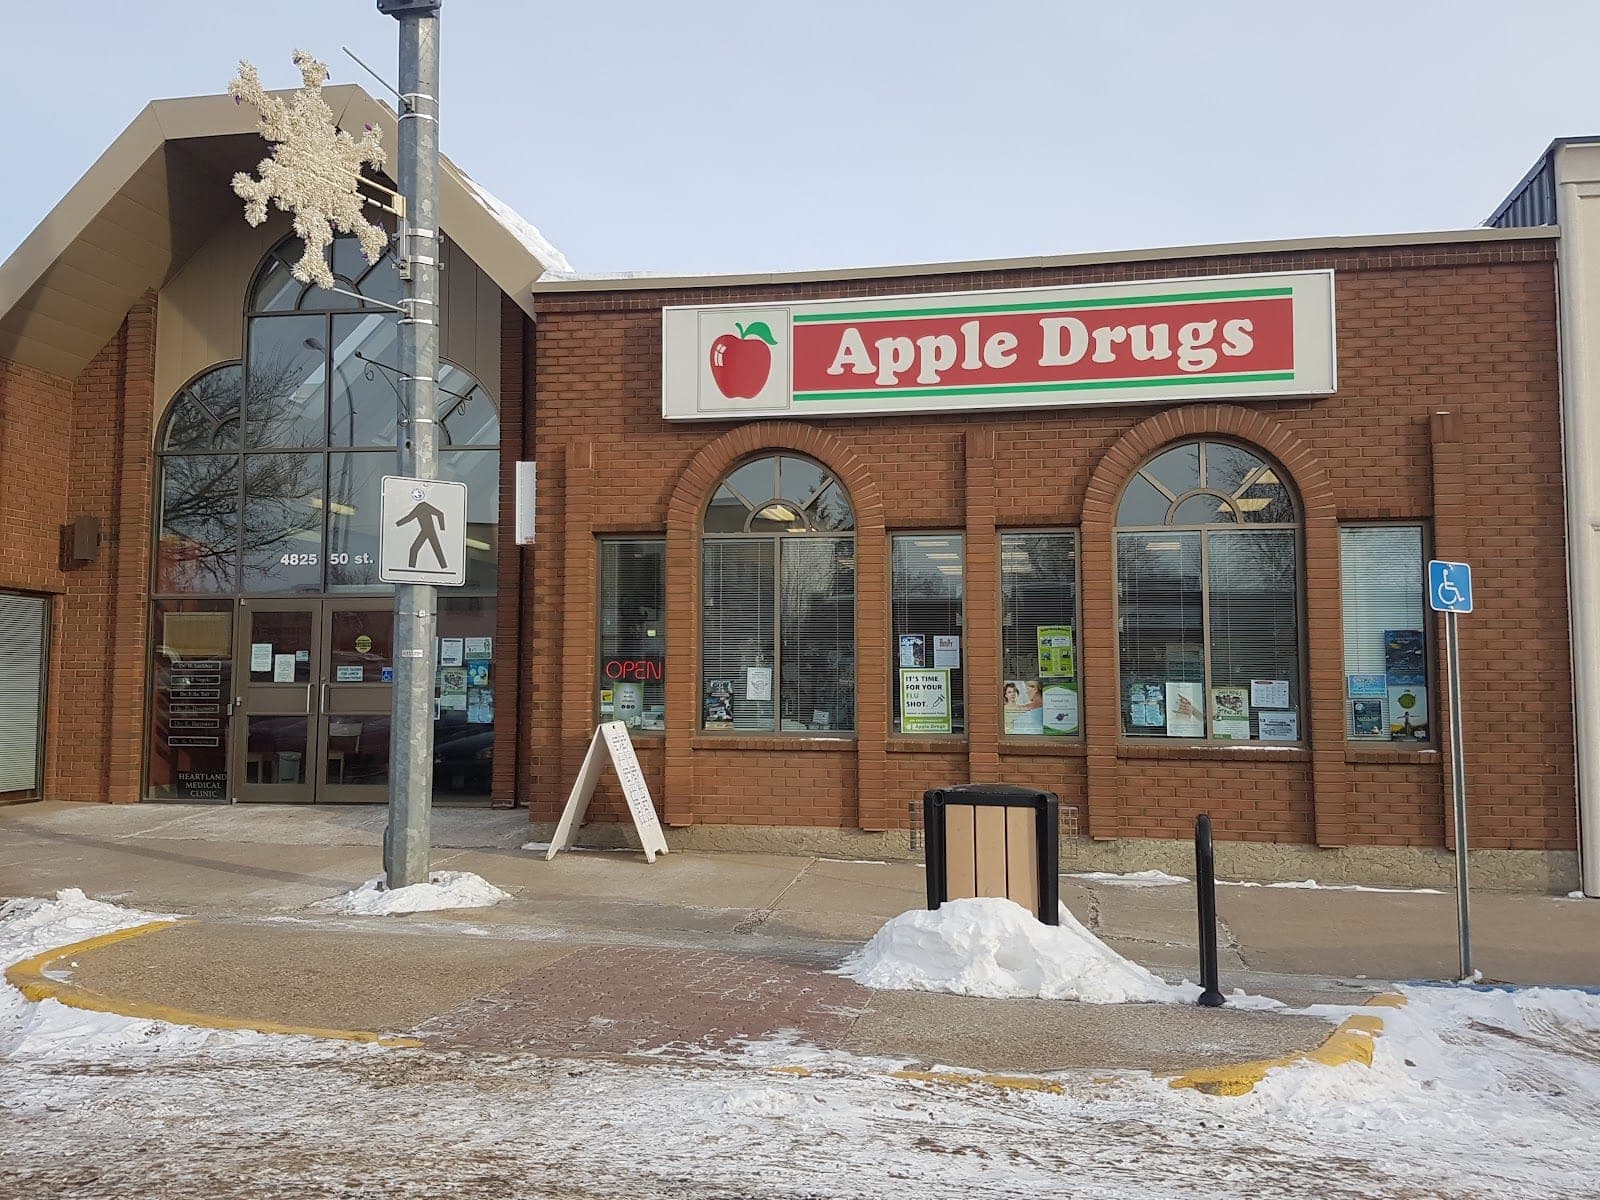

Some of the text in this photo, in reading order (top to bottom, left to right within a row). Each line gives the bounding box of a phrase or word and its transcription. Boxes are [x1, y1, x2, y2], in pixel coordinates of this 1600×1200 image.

[826, 316, 1254, 386] Apple Drugs
[280, 553, 374, 566] 4825 50 st.
[605, 659, 662, 681] OPEN
[905, 675, 939, 683] IT'S TIME
[178, 773, 228, 781] HEARTLAND
[190, 790, 218, 798] CLINIC
